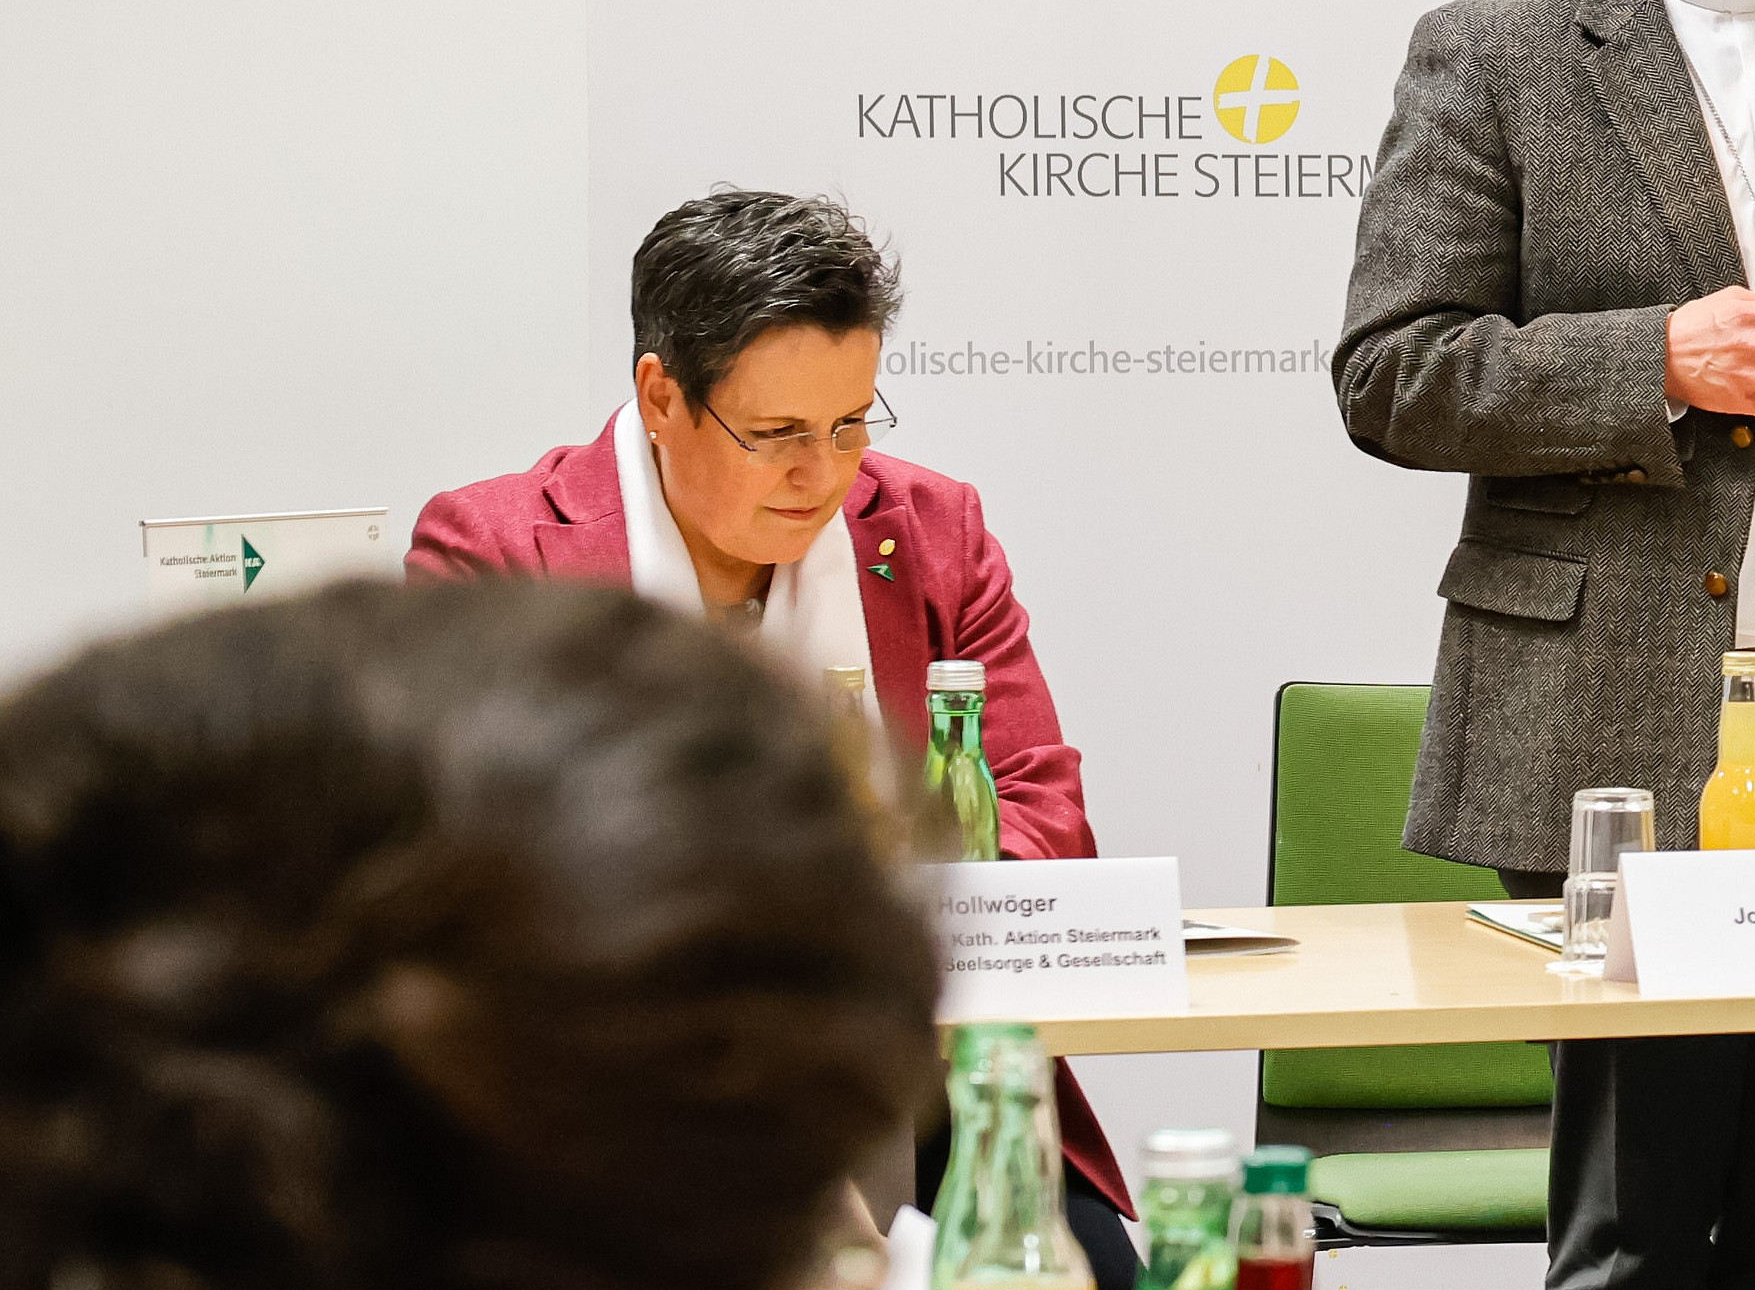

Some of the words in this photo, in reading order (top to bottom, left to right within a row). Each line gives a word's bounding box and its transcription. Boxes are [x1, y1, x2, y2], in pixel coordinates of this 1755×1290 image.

[858, 93, 1203, 140] KATHOLISCHE
[999, 153, 1179, 198] KIRCHE
[884, 339, 1331, 377] olische-kirche-steiermark
[1004, 930, 1061, 945] Aktion
[1067, 927, 1161, 944] Steiermark
[1038, 954, 1051, 969] &
[1057, 951, 1167, 969] Gesellschaft
